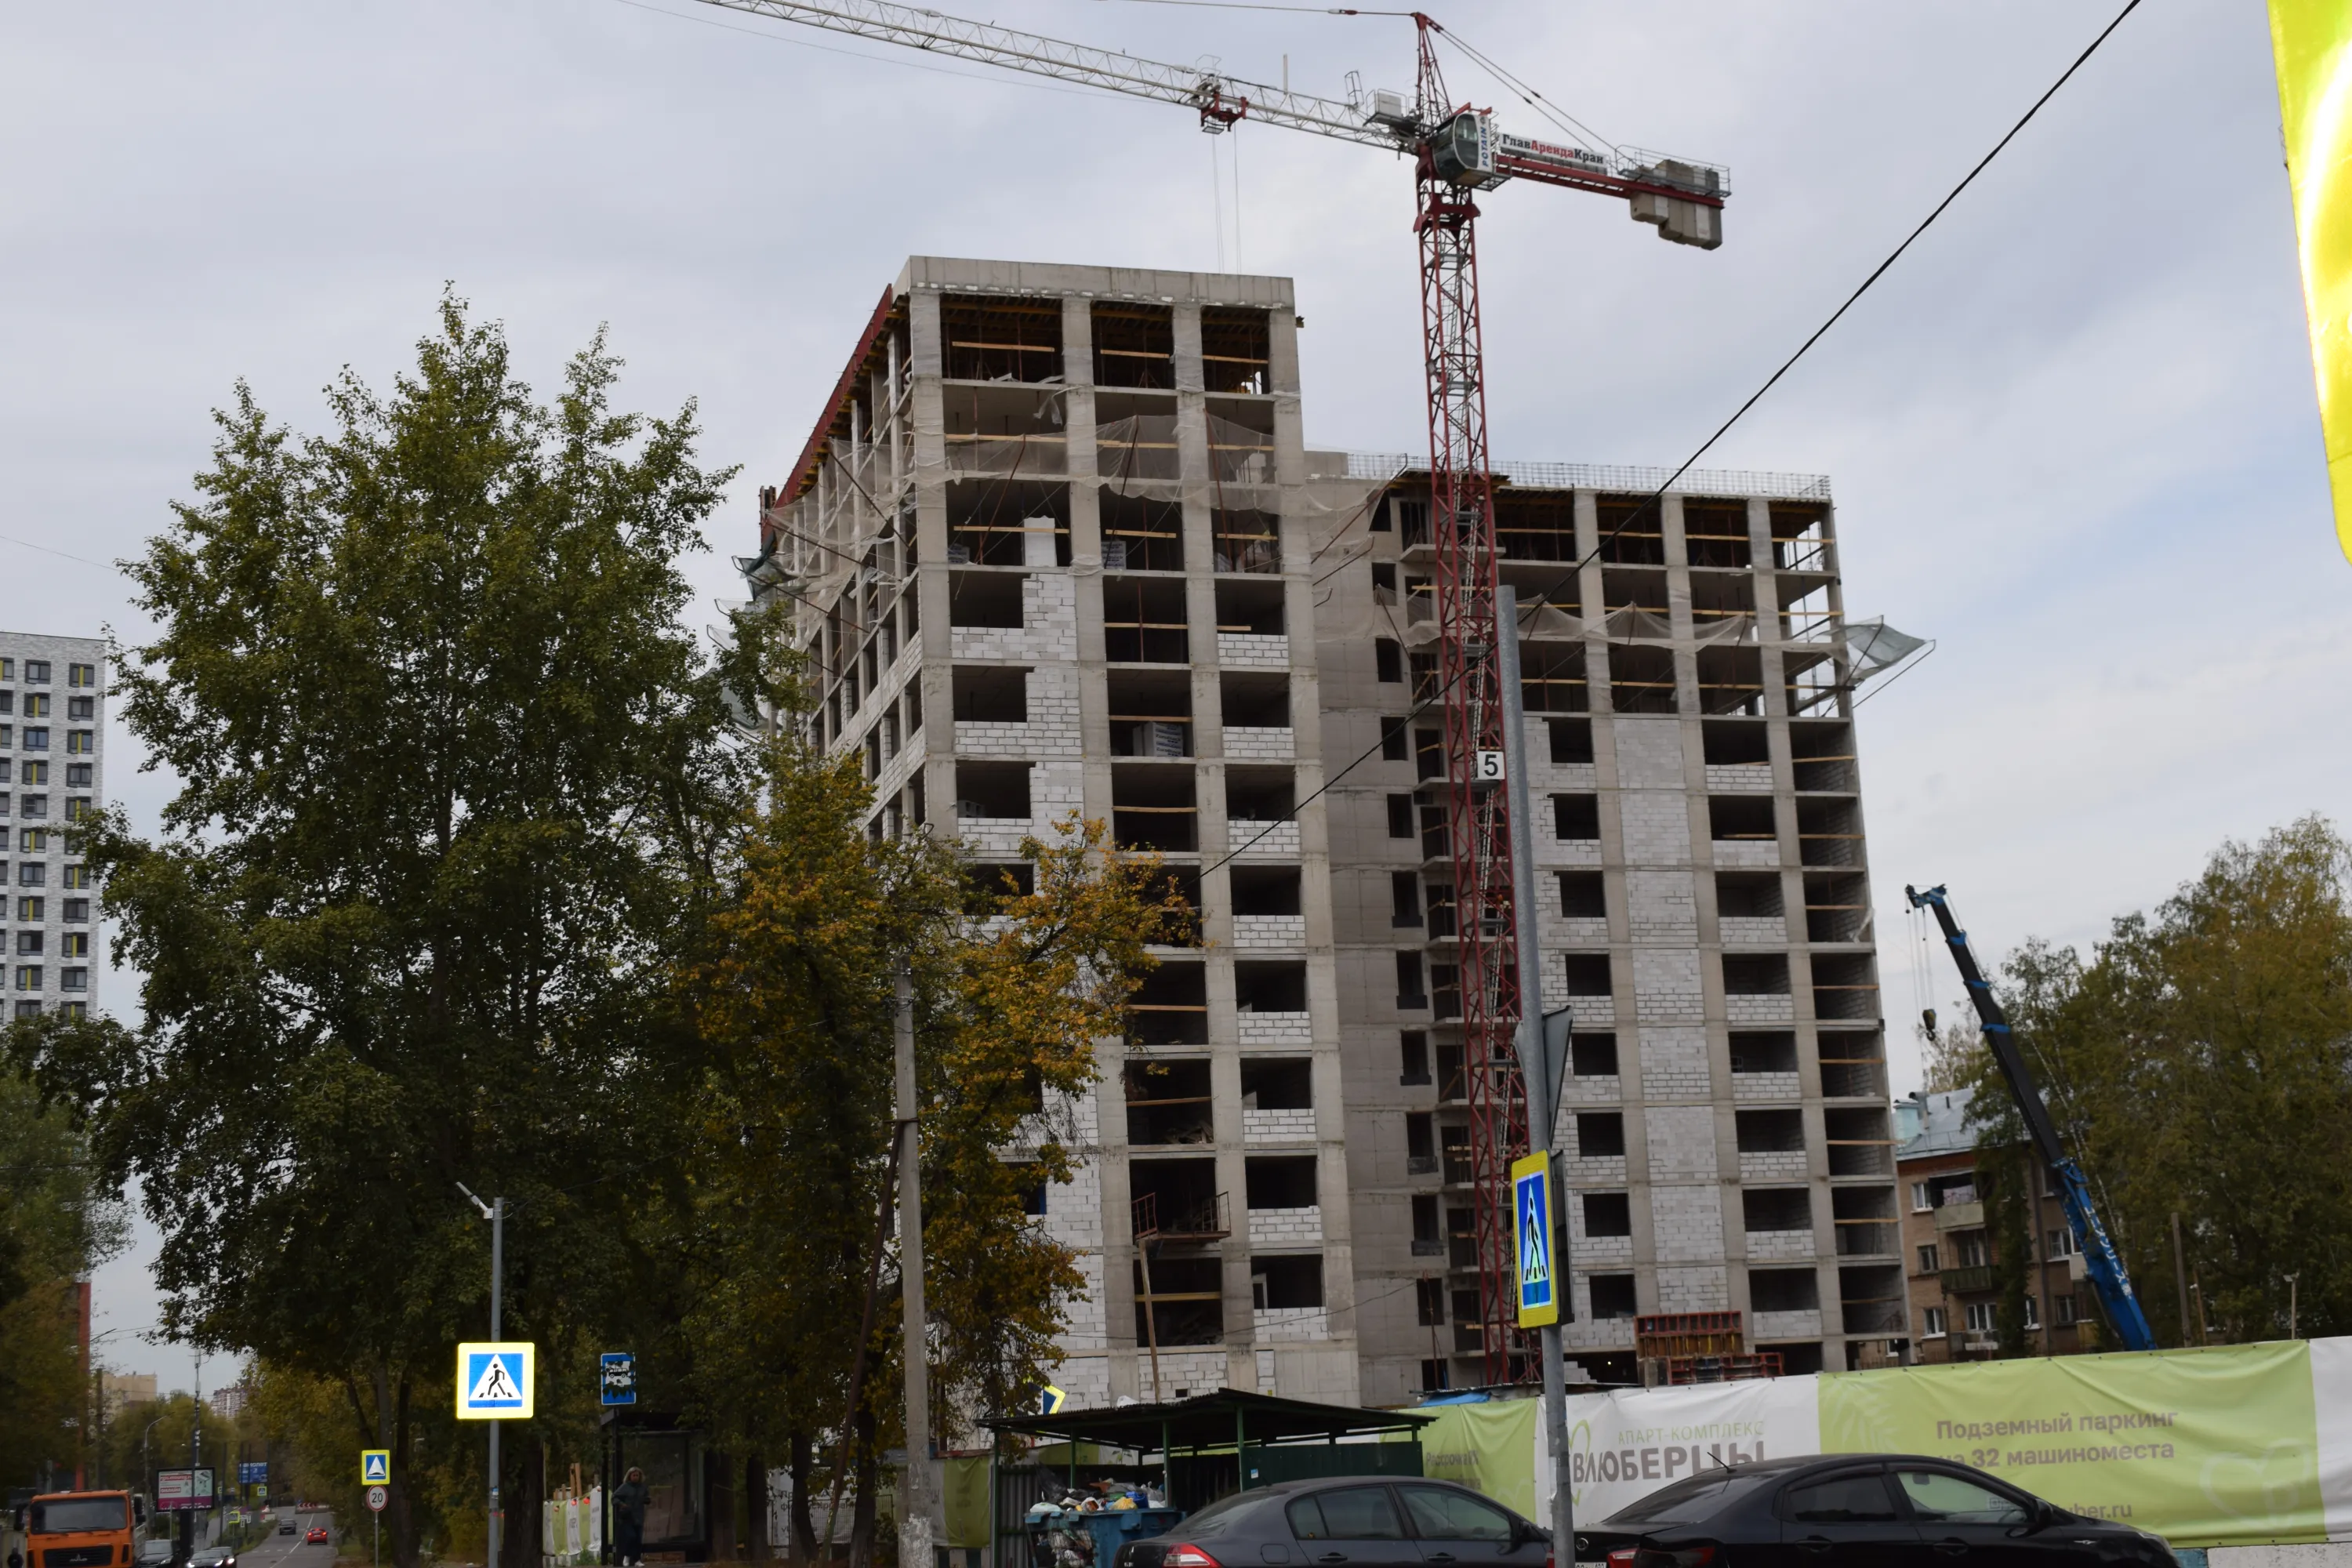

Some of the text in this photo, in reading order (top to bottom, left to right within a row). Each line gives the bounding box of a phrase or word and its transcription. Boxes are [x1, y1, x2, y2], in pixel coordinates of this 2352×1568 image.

[1480, 126, 1489, 167] POTAIN
[1502, 133, 1604, 165] ГлавАрендаКран
[1483, 753, 1498, 777] 5
[1617, 1421, 1765, 1446] АПАРТ-КОМПЛЕКС
[1936, 1411, 2178, 1441] Подземный паркинг
[1971, 1447, 2000, 1468] 32
[2006, 1443, 2176, 1467] машиноместа
[372, 1492, 383, 1504] 20
